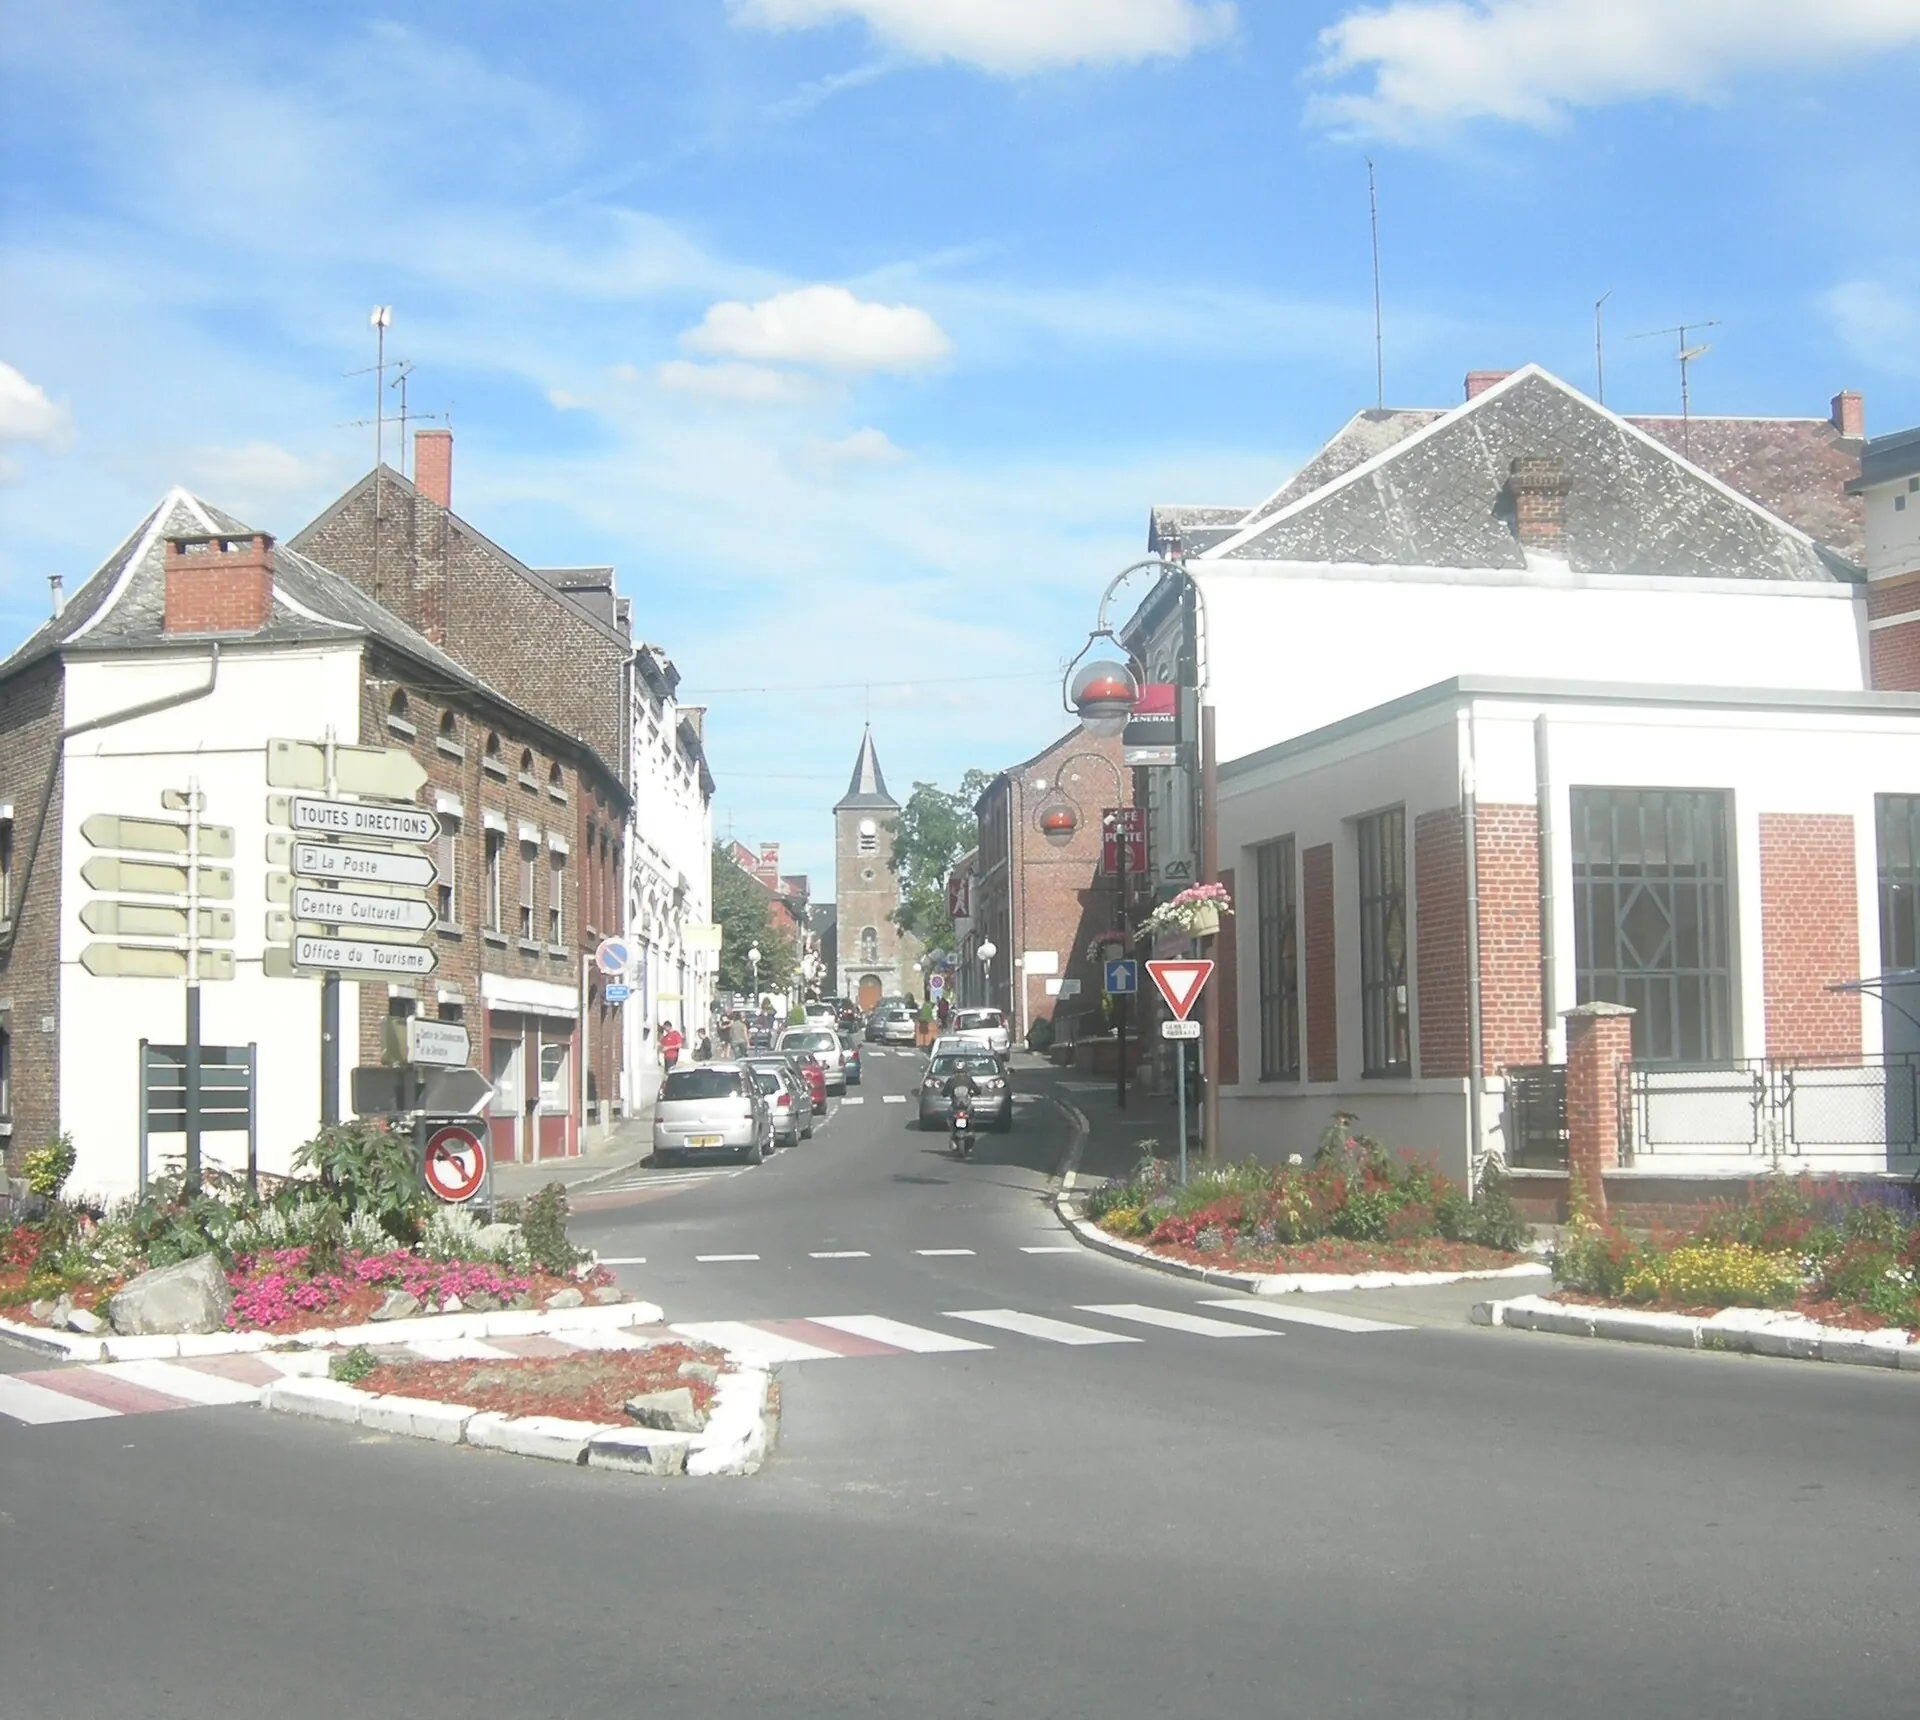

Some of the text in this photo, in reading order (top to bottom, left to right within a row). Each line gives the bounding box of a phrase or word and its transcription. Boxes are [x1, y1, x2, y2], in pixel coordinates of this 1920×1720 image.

[301, 807, 428, 834] TOUTES DIRECTIONS
[321, 854, 378, 874] La Poste
[301, 897, 400, 920] Centre Culturel
[303, 943, 424, 967] Office du Tourisme
